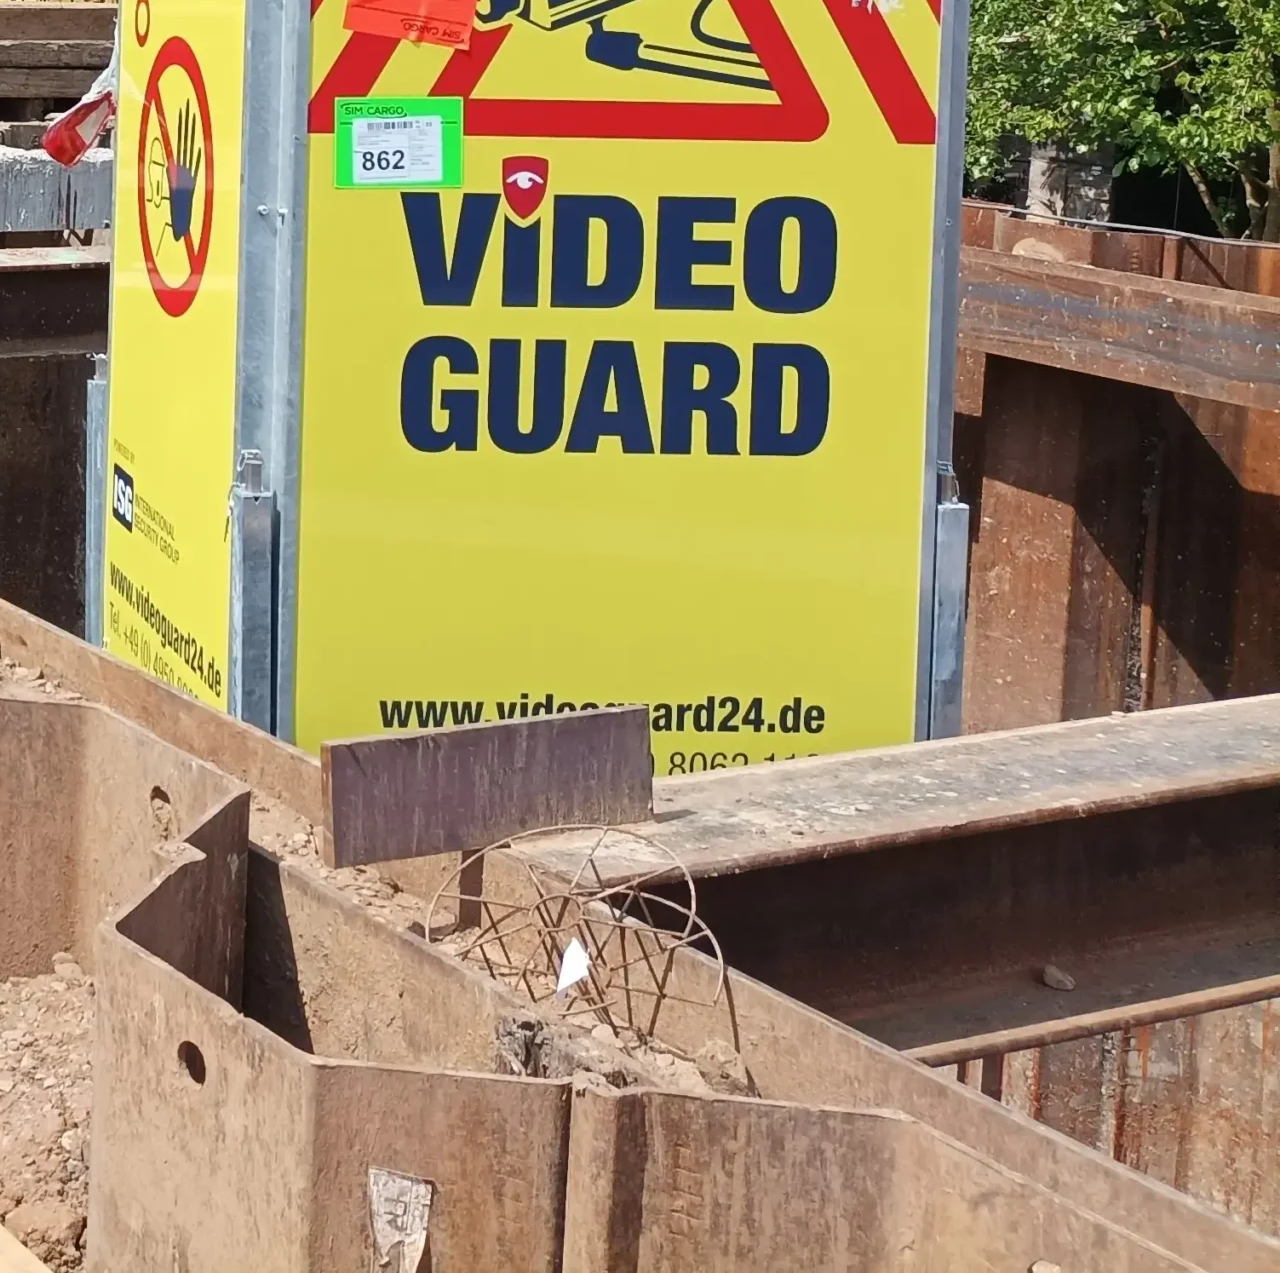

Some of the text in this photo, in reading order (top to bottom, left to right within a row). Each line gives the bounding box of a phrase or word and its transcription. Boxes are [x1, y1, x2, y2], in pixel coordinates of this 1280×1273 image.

[344, 106, 404, 115] SIM CARGO
[362, 150, 405, 171] 862
[400, 335, 830, 457] GUARD
[113, 474, 133, 523] ISG
[110, 561, 221, 698] www.videoguard24.de
